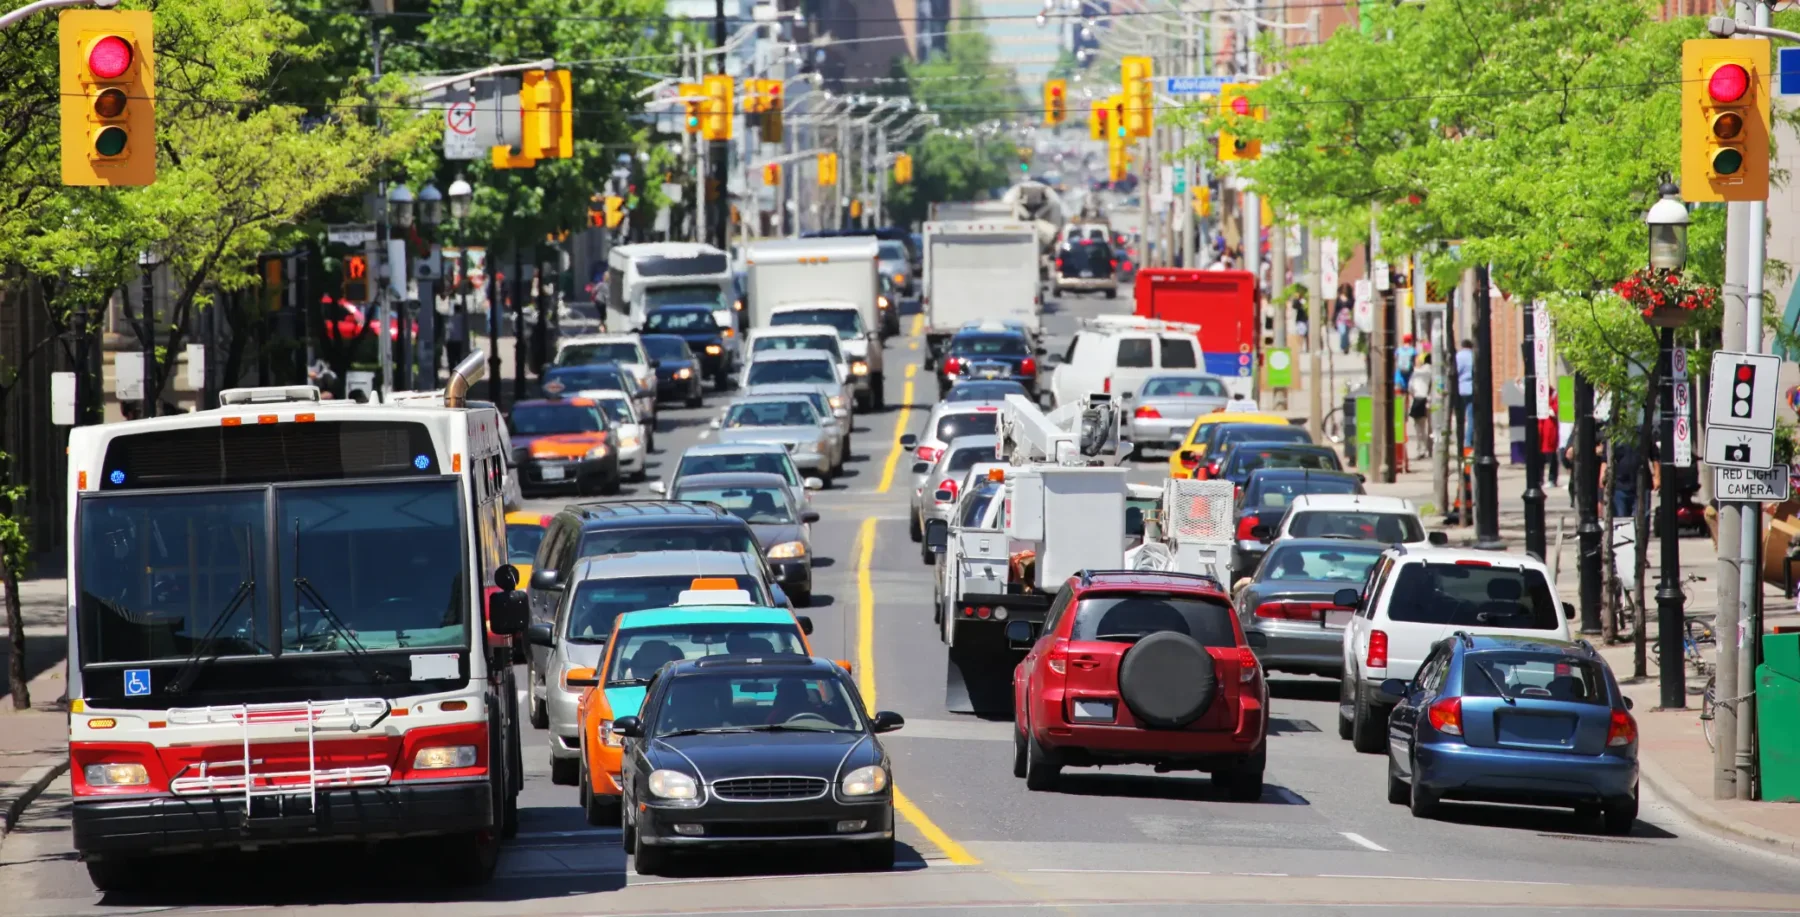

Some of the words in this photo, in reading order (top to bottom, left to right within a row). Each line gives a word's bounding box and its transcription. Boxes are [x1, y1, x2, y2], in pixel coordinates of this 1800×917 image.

[1722, 469, 1742, 480] RED
[1746, 469, 1780, 480] LIGHT
[1727, 484, 1774, 495] CAMERA
